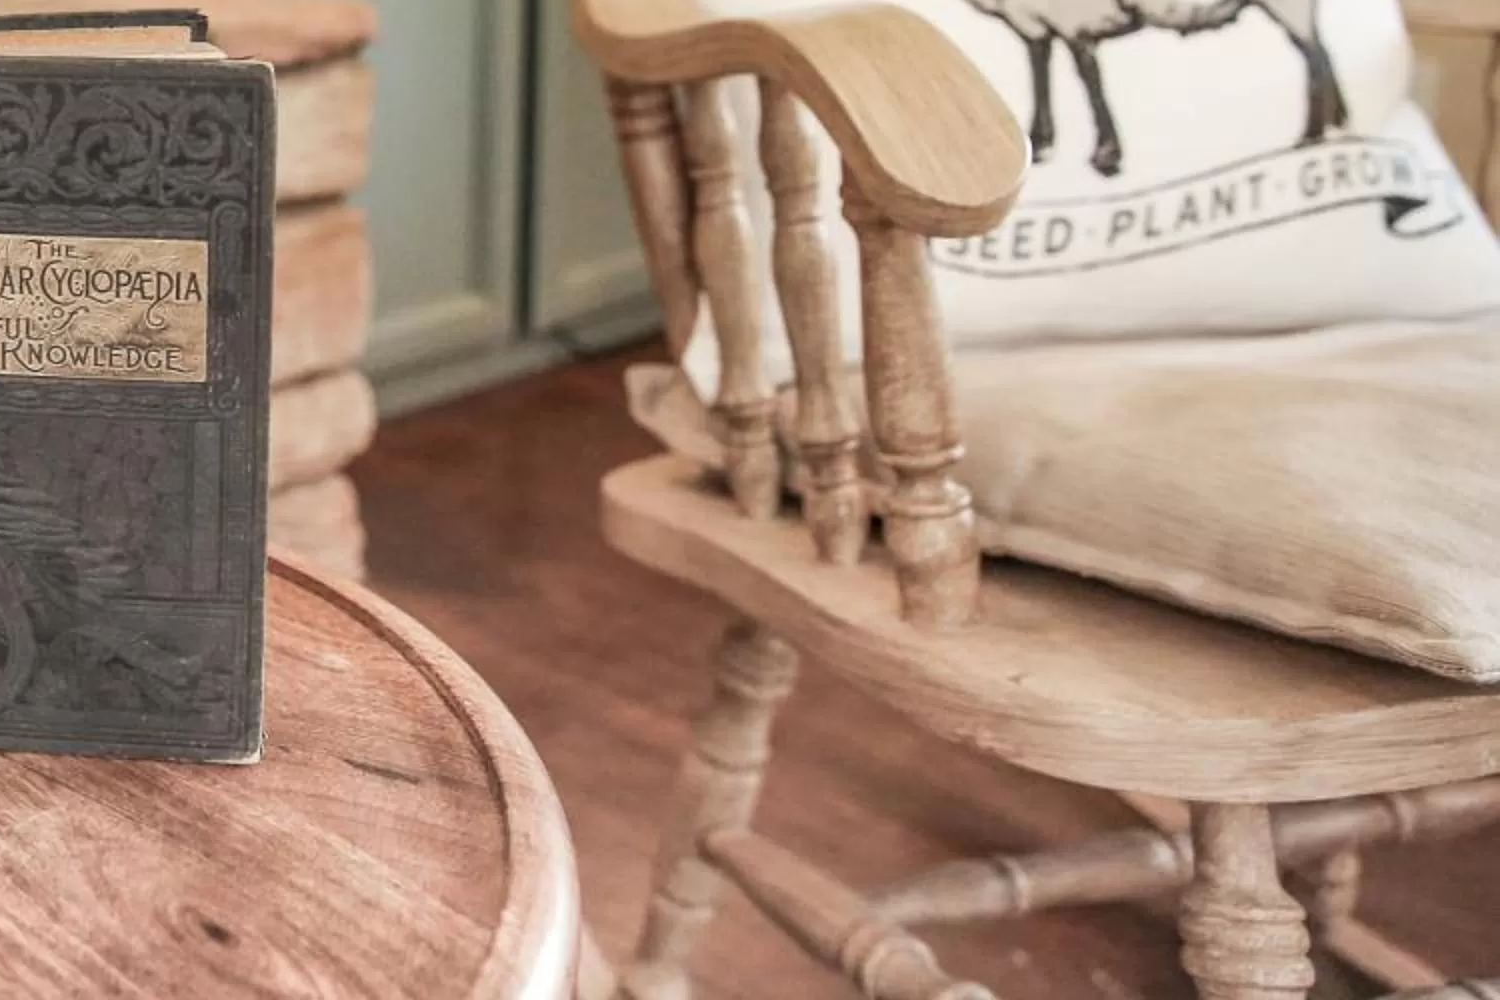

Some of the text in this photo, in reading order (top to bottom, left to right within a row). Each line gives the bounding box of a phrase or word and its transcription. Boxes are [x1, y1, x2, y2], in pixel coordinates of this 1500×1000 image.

[1106, 173, 1266, 248] PLANT
[25, 239, 93, 260] THE
[0, 340, 197, 373] KNOWLEDGE
